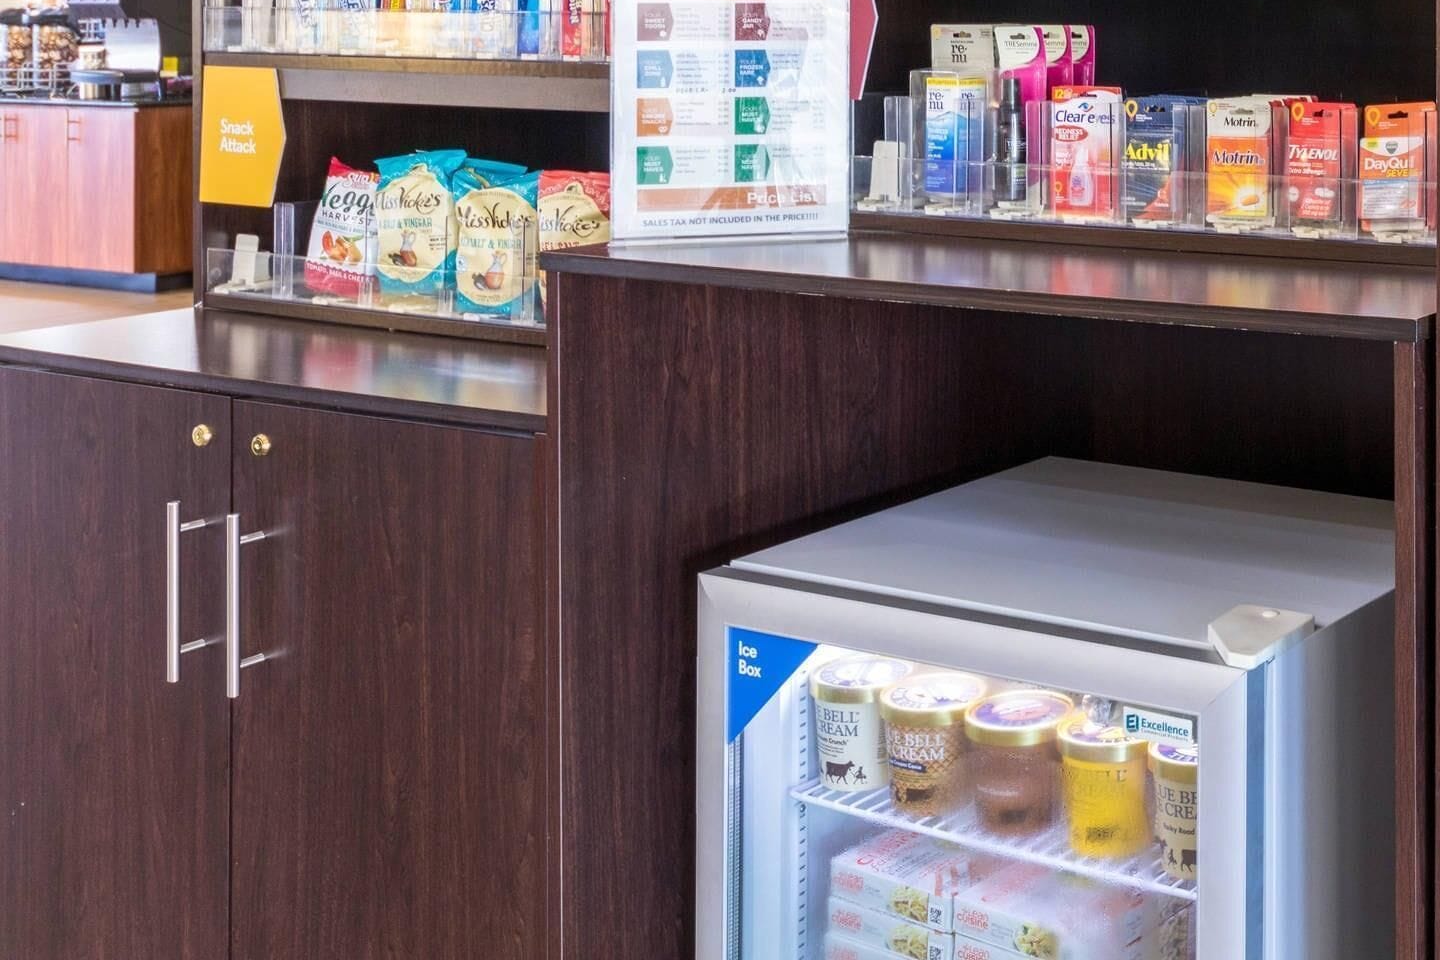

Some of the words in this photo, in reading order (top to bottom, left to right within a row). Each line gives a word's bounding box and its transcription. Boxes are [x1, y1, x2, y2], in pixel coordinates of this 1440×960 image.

[952, 54, 968, 63] nu
[929, 101, 944, 110] nu
[1055, 110, 1086, 123] Clear
[1224, 115, 1257, 129] Motrin
[220, 117, 255, 136] Snack
[219, 136, 257, 154] Attack
[1125, 140, 1171, 162] Advil
[1288, 144, 1338, 161] TYLENOL
[1213, 148, 1263, 167] Motrin
[399, 186, 442, 216] Vickie's
[791, 190, 817, 204] List
[643, 218, 668, 228] SALES
[670, 217, 688, 227] TAX
[688, 216, 707, 226] NOT
[709, 215, 751, 225] INCLUDED
[753, 214, 763, 223] IN
[765, 214, 780, 223] THE
[738, 640, 758, 659] Ice
[738, 658, 762, 679] Box
[824, 710, 860, 725] BELL
[1141, 717, 1190, 738] Excellence
[904, 732, 944, 748] BELL
[893, 745, 945, 762] CREAM
